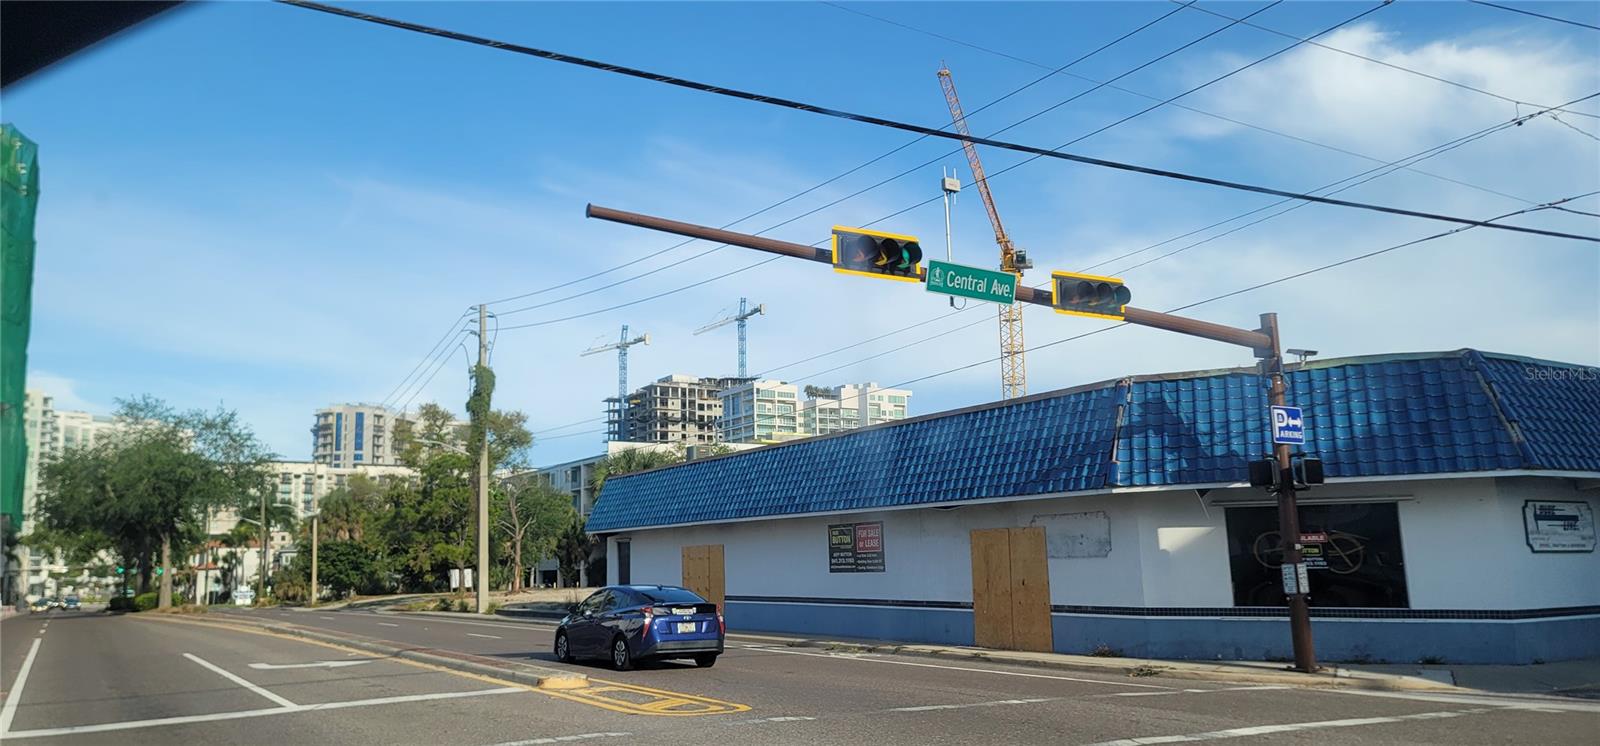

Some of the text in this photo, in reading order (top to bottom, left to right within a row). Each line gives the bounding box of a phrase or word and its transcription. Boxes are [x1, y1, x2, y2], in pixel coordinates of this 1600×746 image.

[947, 271, 1012, 298] Central Ave.
[858, 528, 879, 538] FOR SALE
[832, 535, 851, 544] BUTTON
[864, 539, 879, 548] LEASE
